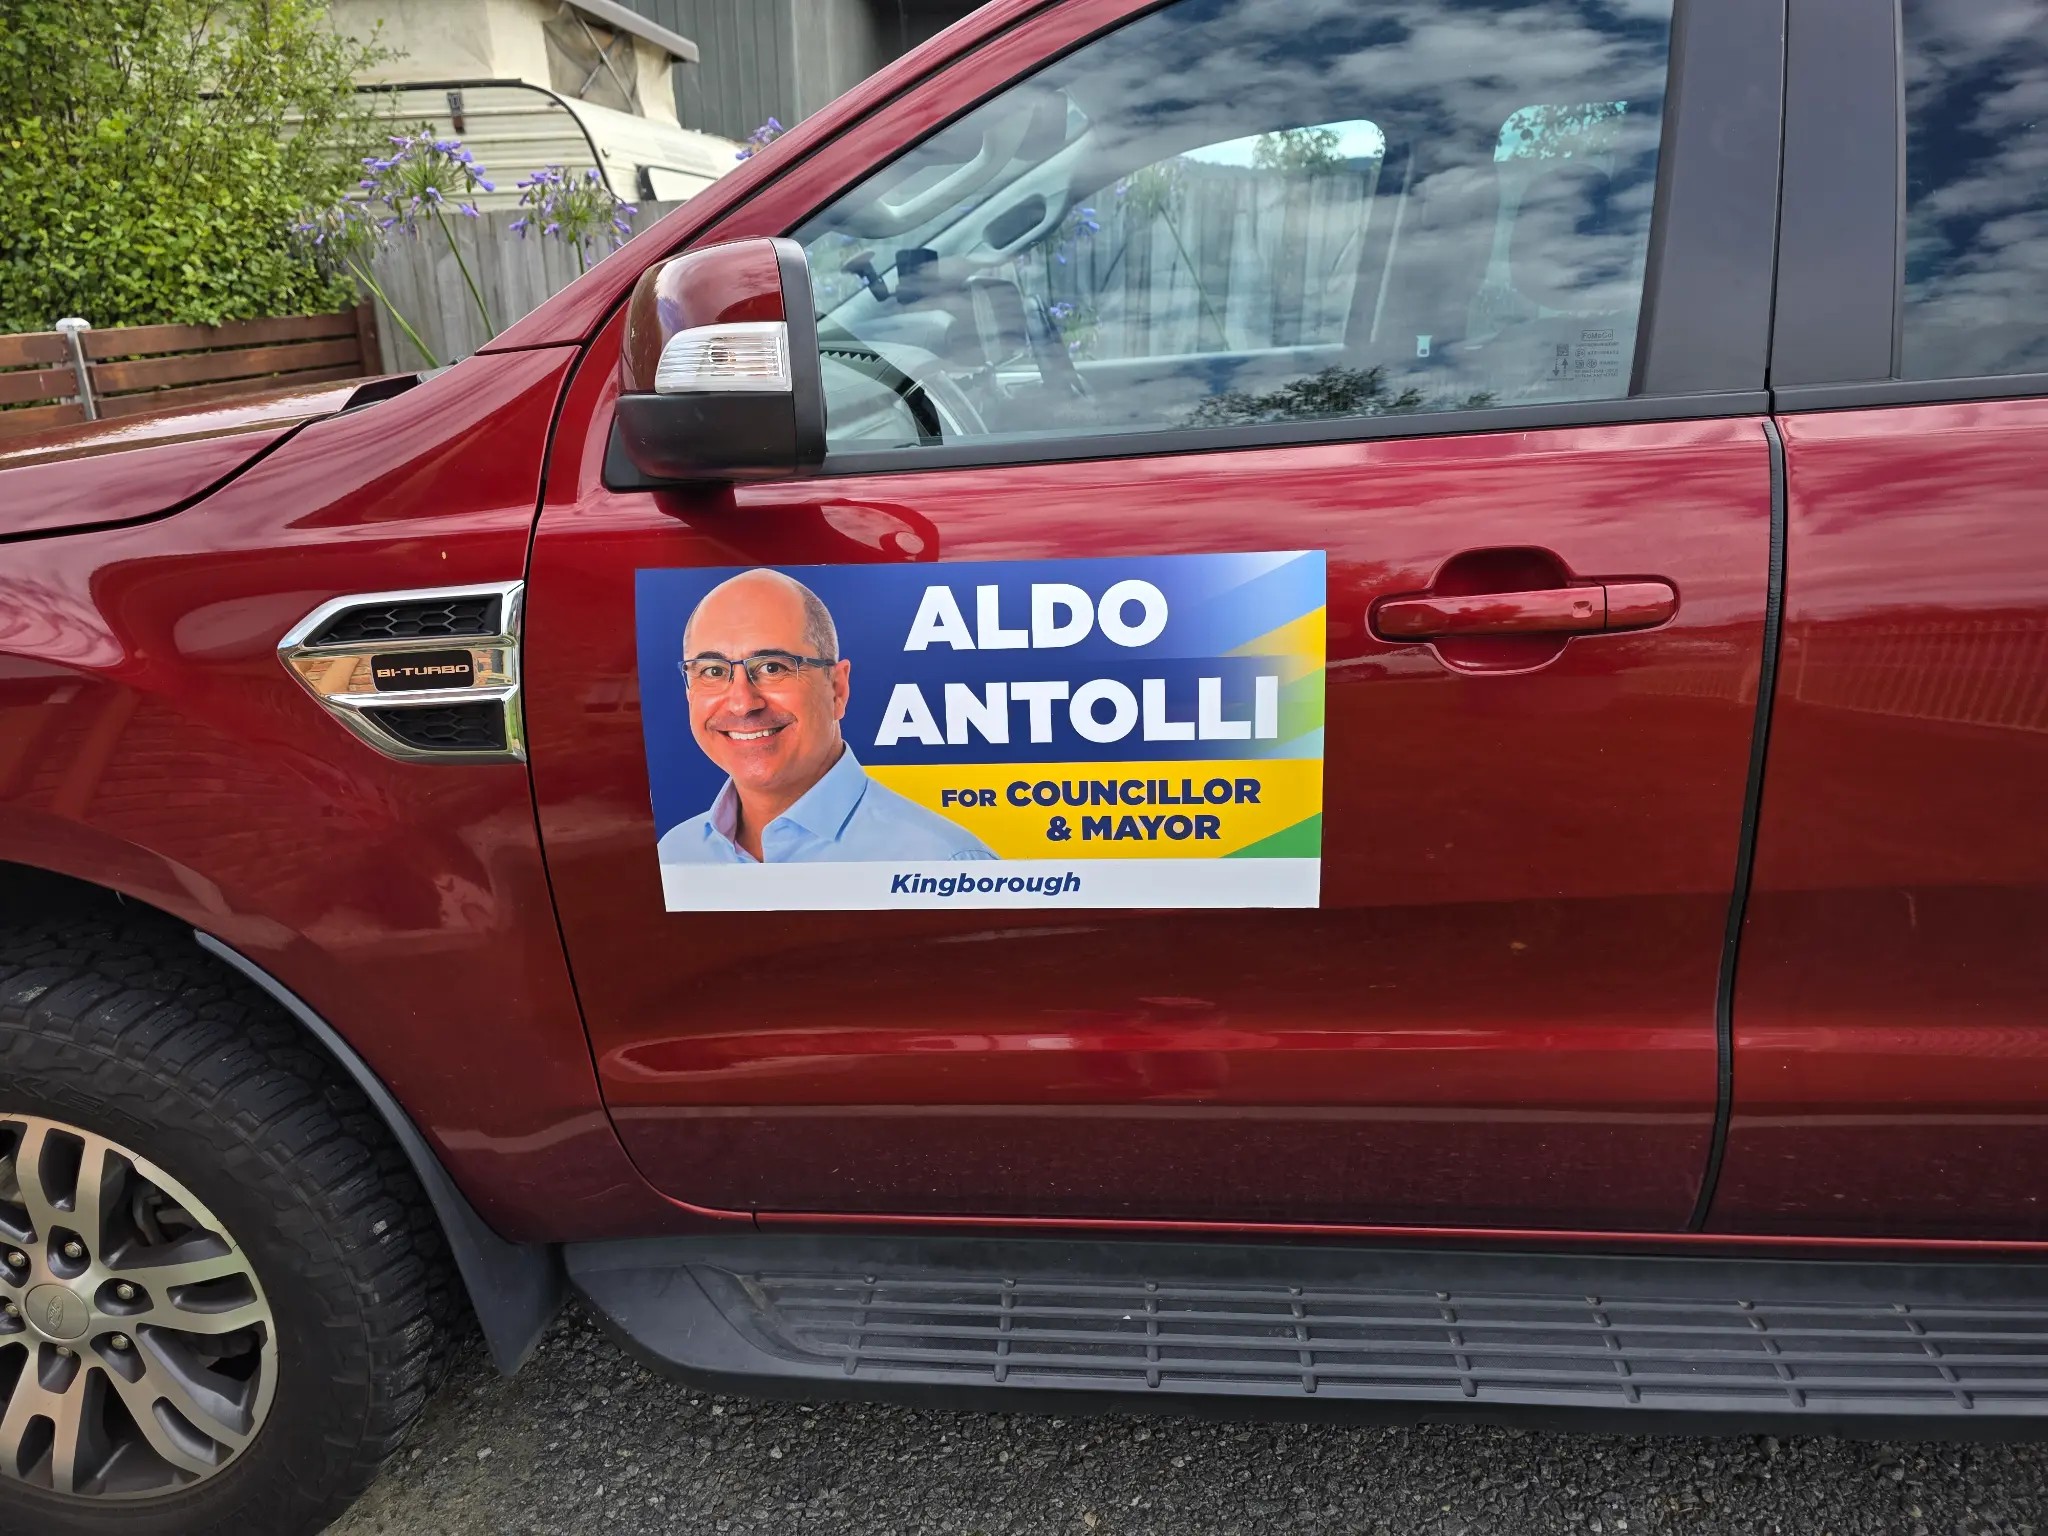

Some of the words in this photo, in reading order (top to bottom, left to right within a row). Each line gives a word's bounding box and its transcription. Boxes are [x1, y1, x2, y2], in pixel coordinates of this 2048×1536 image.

[903, 579, 1168, 652] ALDO
[376, 664, 470, 678] BI-TURBO
[873, 675, 1279, 746] ANTOLLI
[941, 788, 997, 808] FOR
[1006, 778, 1262, 807] COUNCILLOR
[1046, 816, 1072, 841] &
[1082, 814, 1221, 841] MAYOR
[890, 871, 1081, 897] Kingborough
